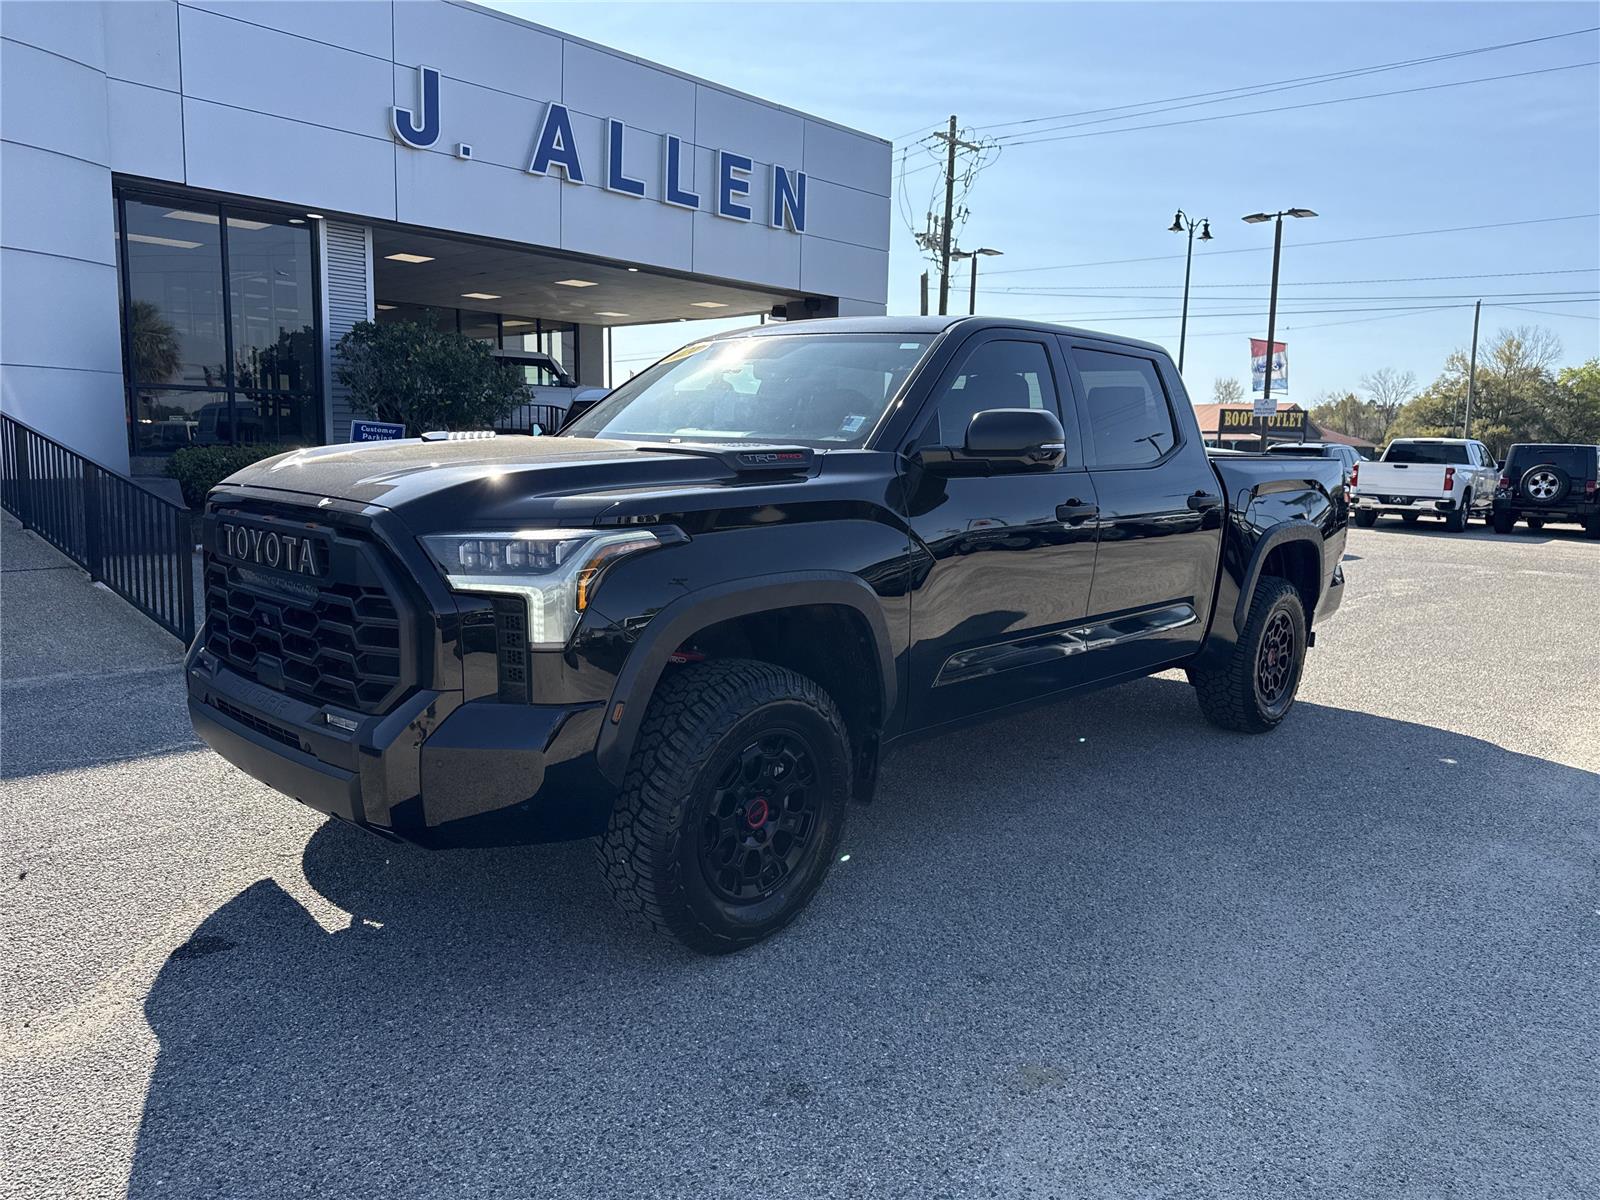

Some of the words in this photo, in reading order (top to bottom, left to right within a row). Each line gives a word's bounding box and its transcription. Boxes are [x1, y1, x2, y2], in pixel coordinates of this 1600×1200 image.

[390, 64, 472, 160] J.
[527, 101, 808, 234] ALLEN
[1224, 411, 1254, 426] BOOT
[1260, 411, 1304, 427] UTLET
[362, 425, 396, 434] Customer
[744, 453, 777, 462] TRD
[224, 523, 318, 575] TOYOTA
